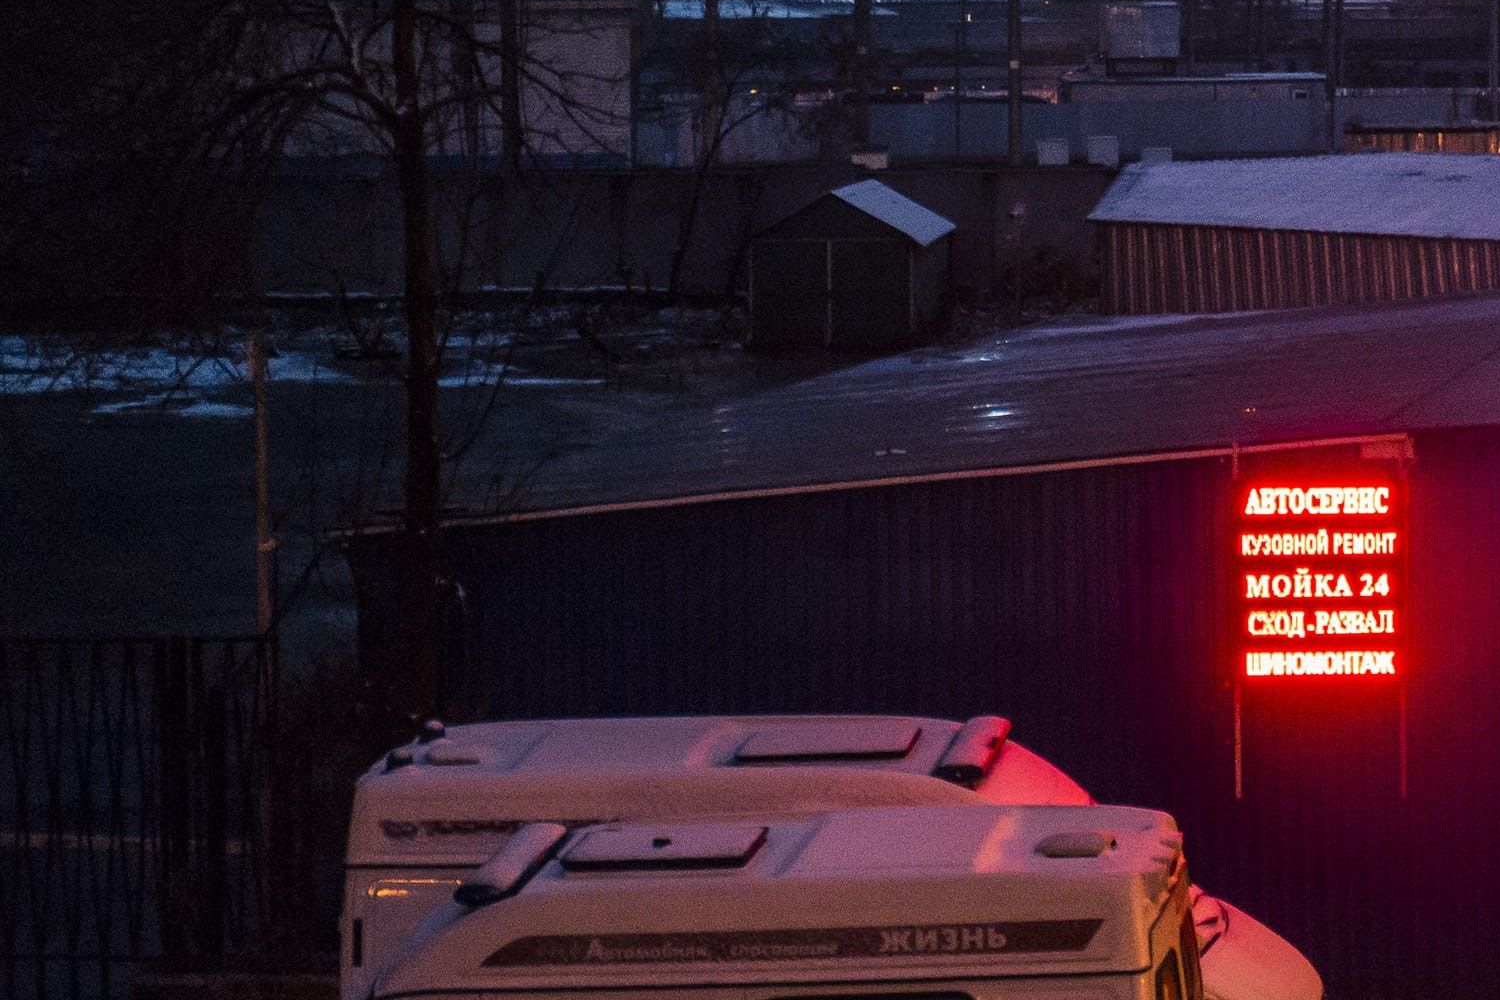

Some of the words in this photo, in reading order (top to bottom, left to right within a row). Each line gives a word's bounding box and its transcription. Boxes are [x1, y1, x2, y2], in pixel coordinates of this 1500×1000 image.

[1244, 486, 1390, 515] АВТОСЕРВИС
[1241, 529, 1330, 556] КУЗОВНОЙ
[1332, 532, 1397, 555] РЕМОНТ
[1245, 568, 1353, 598] МОЙКА
[1359, 573, 1390, 597] 24
[1245, 651, 1396, 676] ШИНОМОНТАЖ
[878, 926, 1008, 954] ЖИЗНЬ
